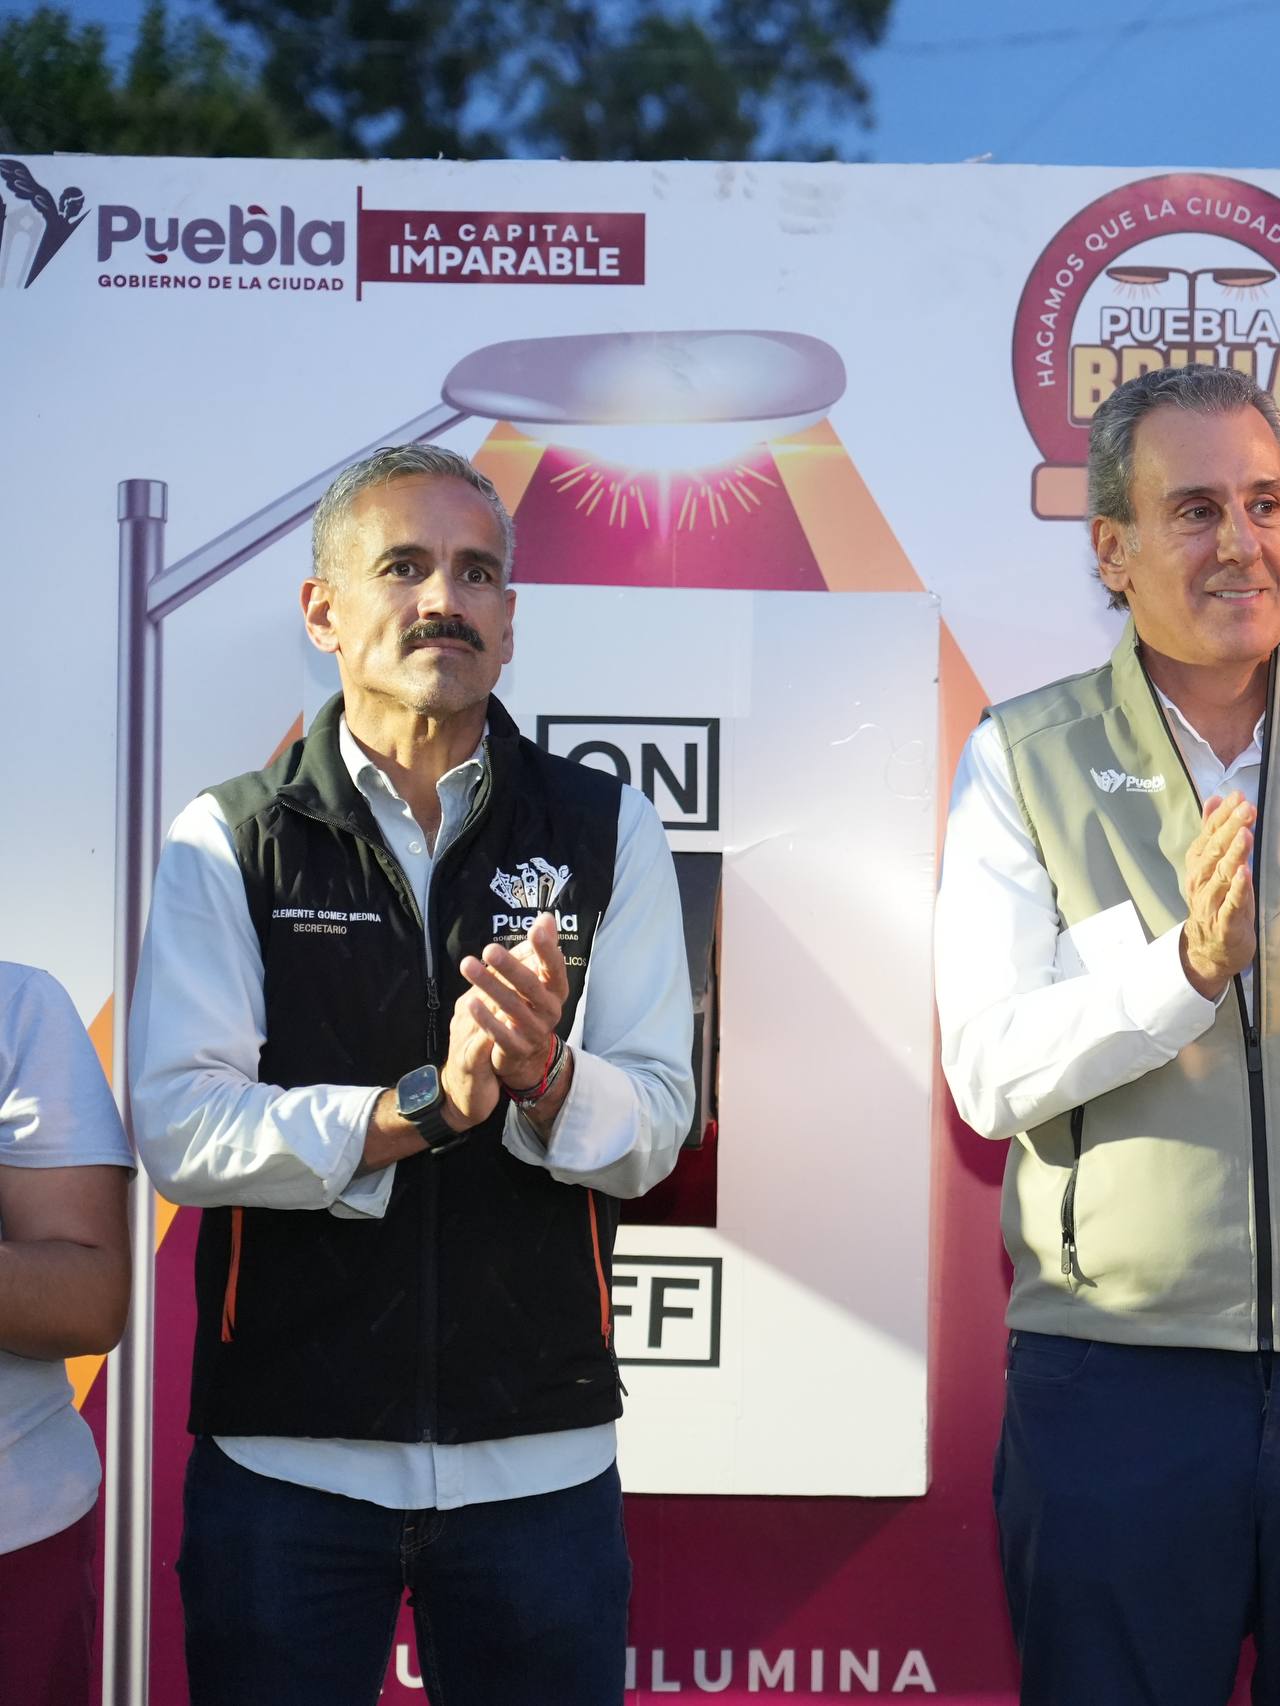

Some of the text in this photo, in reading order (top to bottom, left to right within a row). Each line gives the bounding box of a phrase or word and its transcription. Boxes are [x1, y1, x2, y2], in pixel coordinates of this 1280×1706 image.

[97, 204, 346, 267] Puebla
[403, 223, 600, 243] LA CAPITAL
[389, 244, 621, 277] IMPARABLE
[97, 274, 345, 292] GOBIERNO DE LA CIUDAD
[1036, 253, 1085, 388] HAGAMOS
[1085, 211, 1136, 252] QUE
[1143, 199, 1176, 222] LA
[271, 908, 382, 923] CLEMENTE GOMEZ MEDINA
[492, 908, 578, 934] Puela
[293, 923, 348, 935] SECRETARIO
[624, 1646, 937, 1693] ILUMINA
